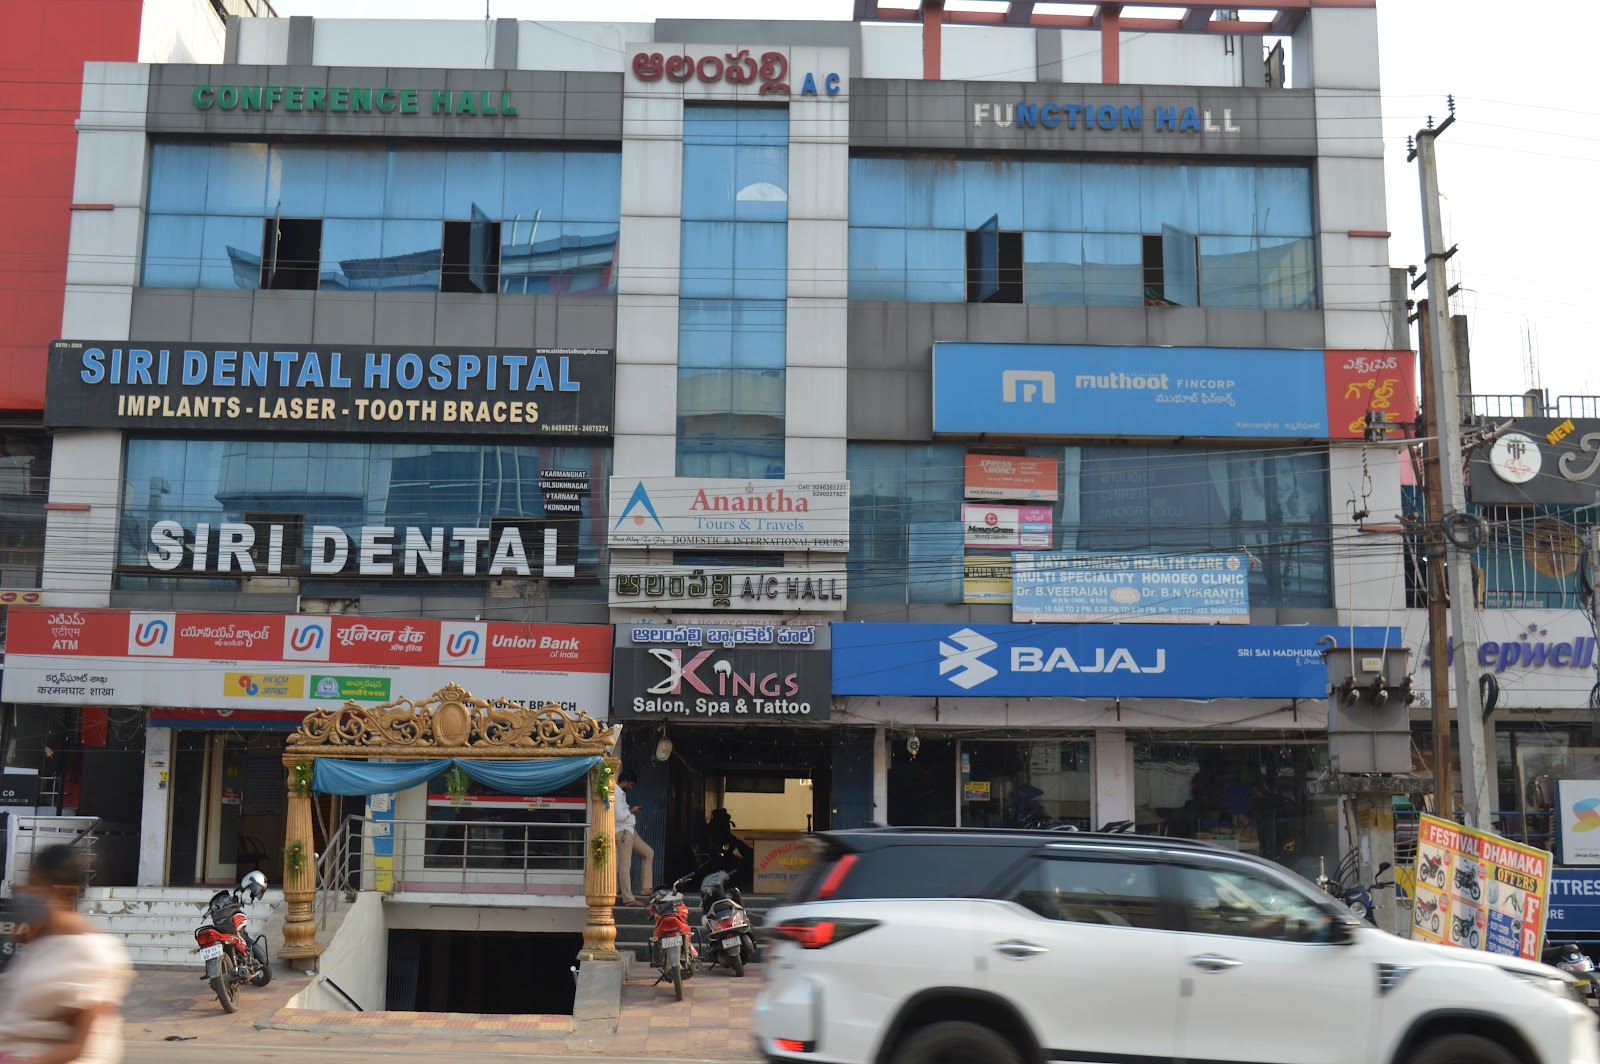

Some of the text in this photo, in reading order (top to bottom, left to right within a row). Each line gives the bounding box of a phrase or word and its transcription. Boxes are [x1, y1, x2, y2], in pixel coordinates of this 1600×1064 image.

[193, 85, 520, 118] CONFERENCE HALL
[973, 102, 1242, 134] FUNCTION HALL
[536, 347, 609, 356] www.siridentalhospital.com
[80, 347, 581, 392] SIRI DENTAL HOSPITAL
[1075, 372, 1236, 391] muthoot FINCORP
[117, 394, 540, 424] IMPLANTS LASER TOOTH BRACES
[1545, 419, 1576, 446] NEW
[980, 459, 1012, 468] XPRESS
[544, 471, 586, 479] KARMANGHAT
[542, 482, 588, 490] DILSUKHNAGAR
[689, 488, 810, 513] Anantha
[547, 504, 580, 512] KONDAPUR
[695, 517, 804, 531] Tours & Travels
[147, 520, 576, 577] SIRI DENTAL
[672, 536, 723, 545] DOMESTIC
[732, 537, 811, 547] INTERNATIONAL
[812, 538, 844, 547] TOURS
[1133, 556, 1185, 570] HEALTH
[1188, 557, 1224, 570] CARE
[1016, 572, 1056, 582] MULTI
[1060, 572, 1135, 583] SPECIALITY
[1142, 573, 1198, 584] HOMOEO
[1201, 573, 1244, 585] CLINIC
[741, 575, 843, 600] A/C HALL
[1016, 587, 1032, 596] Dr.
[1142, 588, 1157, 597] Dr.
[1161, 588, 1181, 597] B.N
[1183, 588, 1244, 598] VIKRANTH
[336, 624, 426, 646] यूनियन बैंक
[52, 640, 79, 650] ATM
[491, 636, 579, 651] Union Bank
[550, 650, 579, 659] of India
[1237, 648, 1270, 657] SRI SAI
[1010, 648, 1165, 674] BAJAJ
[37, 686, 115, 697] करमनघाट शाखा
[633, 697, 811, 716] Salon, Spa & Tattoo
[1429, 825, 1480, 857] FESTIVAL
[1483, 841, 1543, 878] DHAMAKA
[1497, 868, 1536, 892] OFFERS
